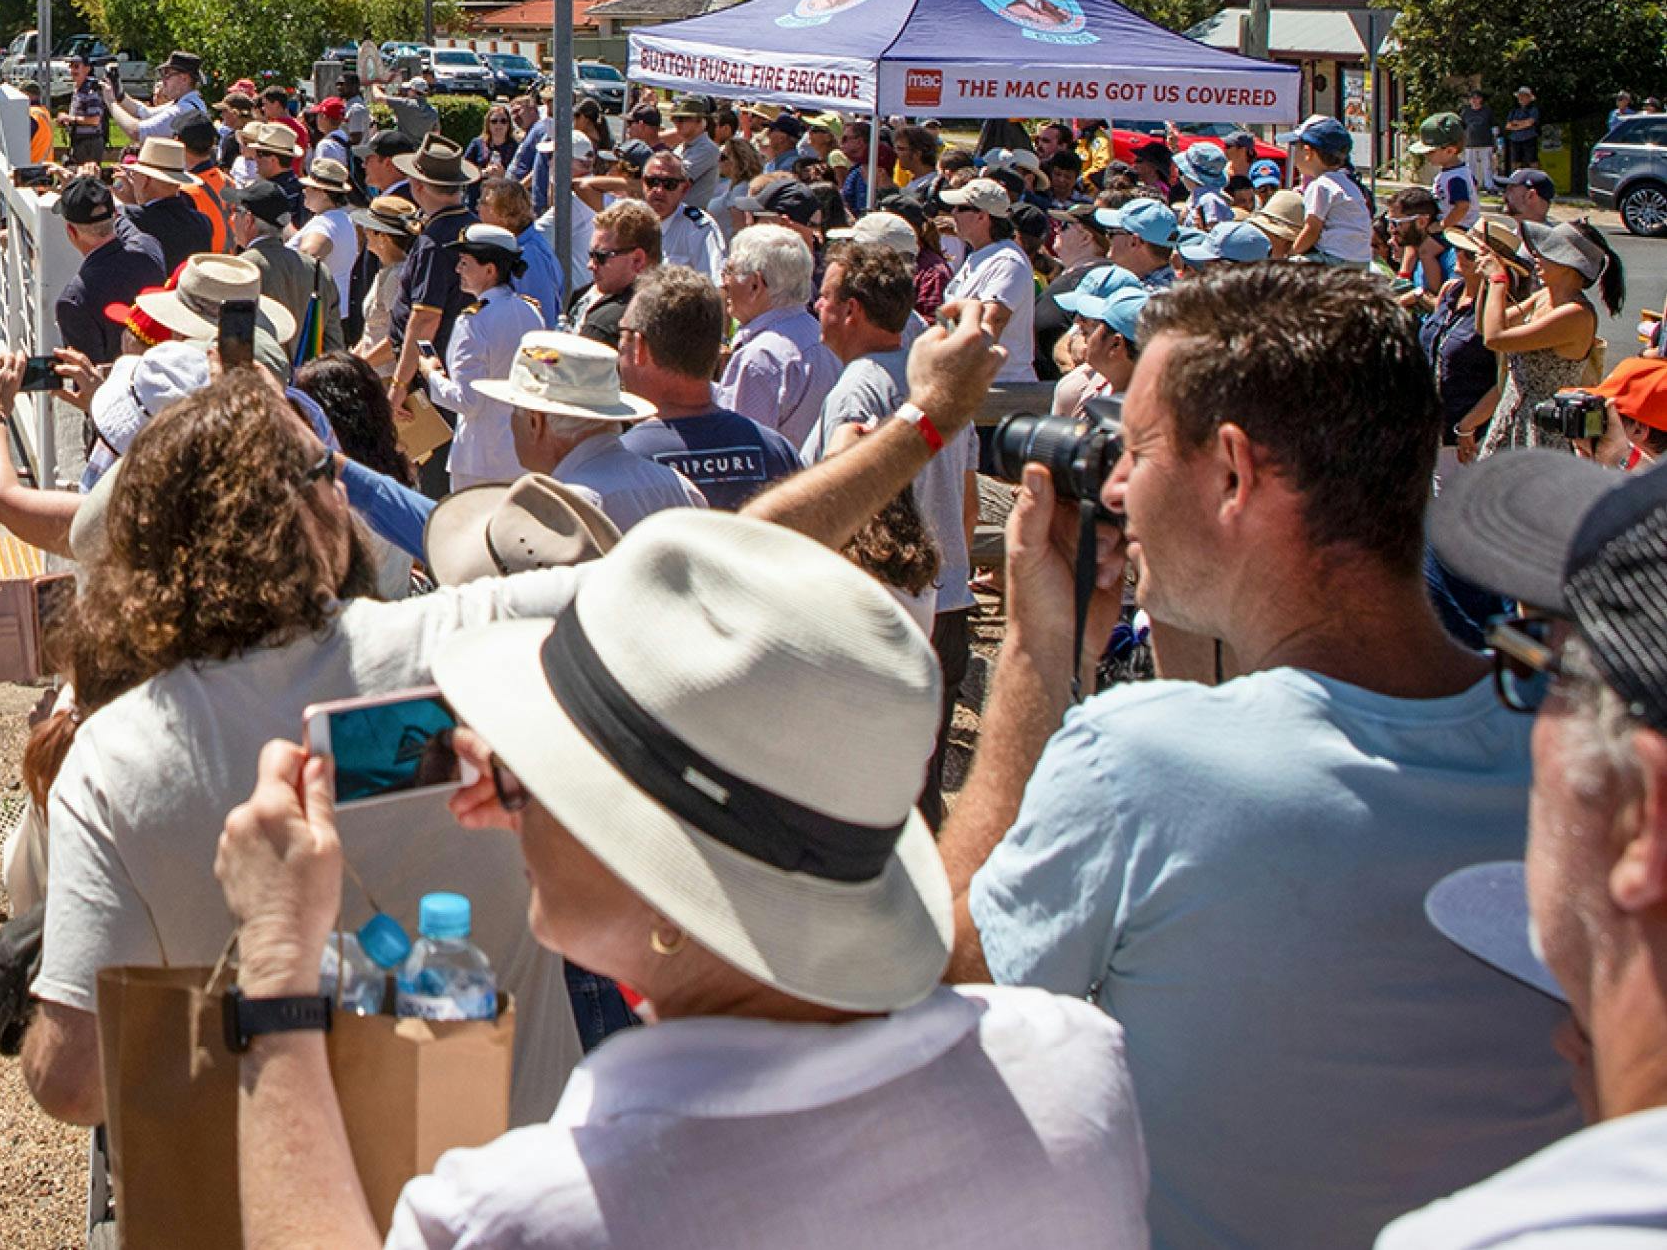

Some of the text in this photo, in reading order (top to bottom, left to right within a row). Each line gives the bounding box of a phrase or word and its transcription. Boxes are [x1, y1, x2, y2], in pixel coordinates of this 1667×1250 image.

[640, 47, 860, 99] BUXTON RURAL FIRE BRIGADE
[908, 74, 942, 87] mac
[957, 79, 1277, 106] THE MAC HAS GOT US COVERED
